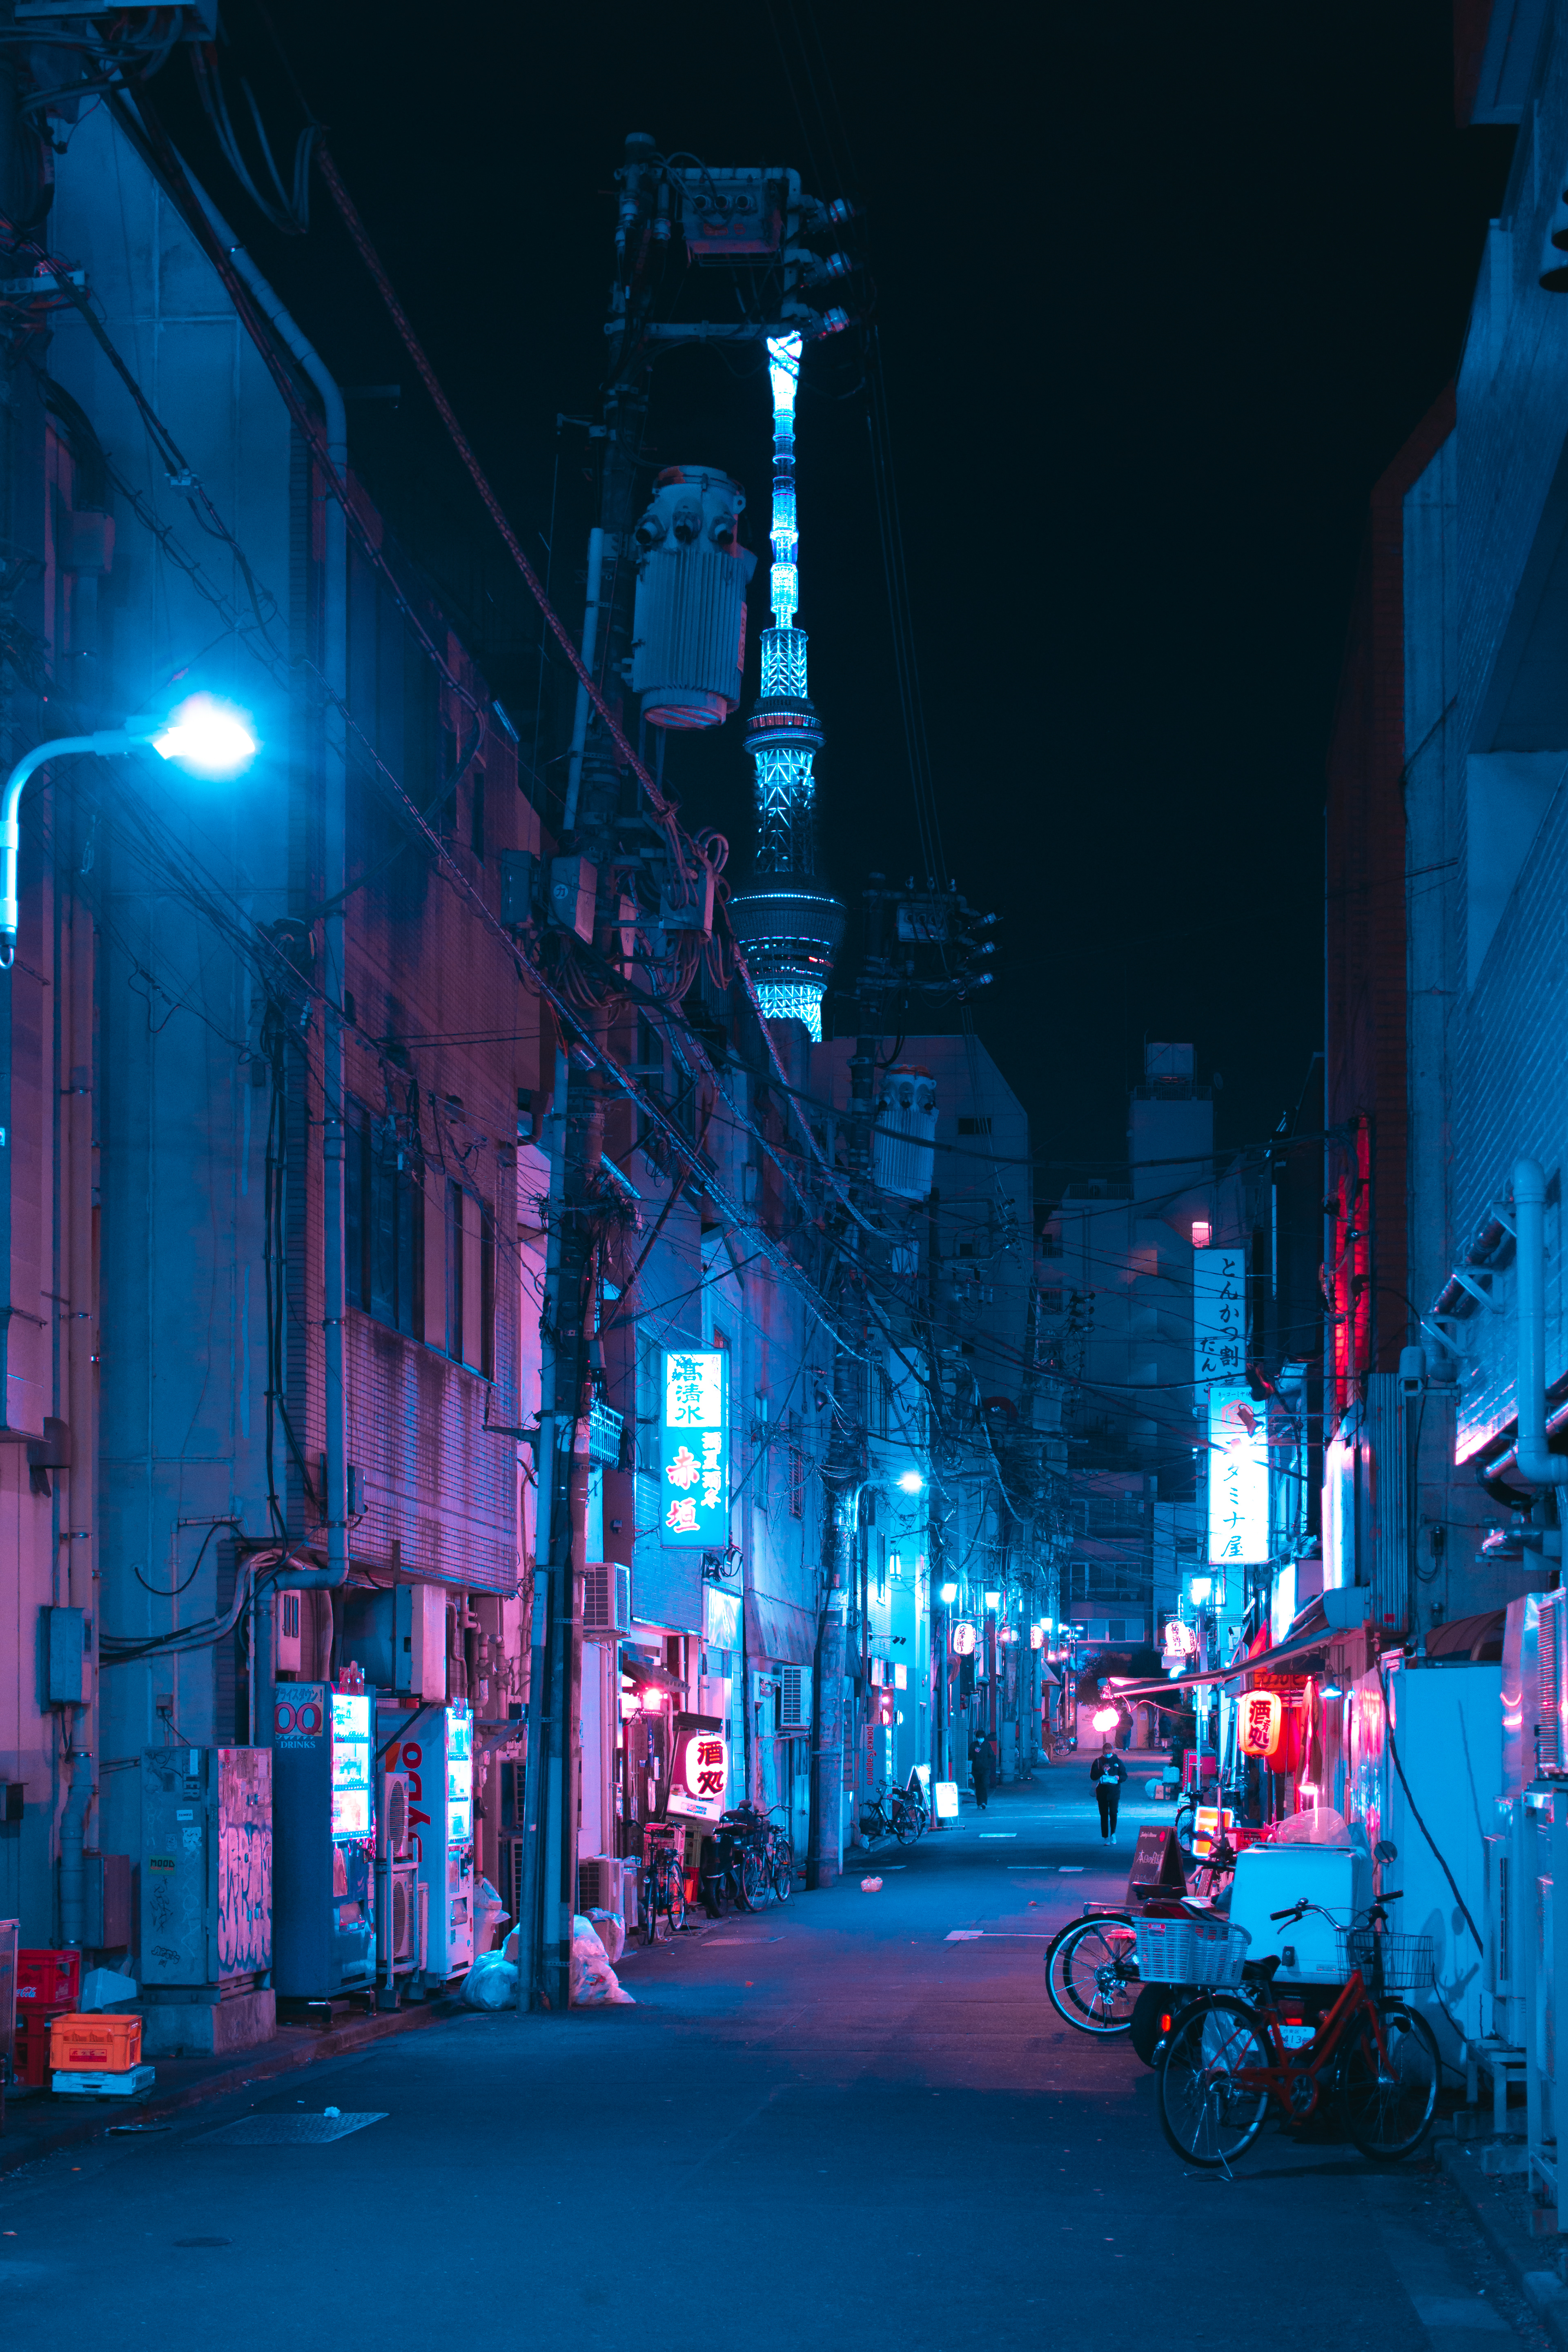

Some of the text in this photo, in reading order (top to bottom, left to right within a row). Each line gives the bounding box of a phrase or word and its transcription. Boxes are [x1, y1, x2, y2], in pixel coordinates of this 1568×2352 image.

[666, 1446, 701, 1533] 赤垣
[1221, 1440, 1245, 1557] タミナ屋
[956, 1625, 968, 1652] たぬき通り
[697, 1741, 724, 1794] 酒処
[150, 1859, 175, 1867] MOOD
